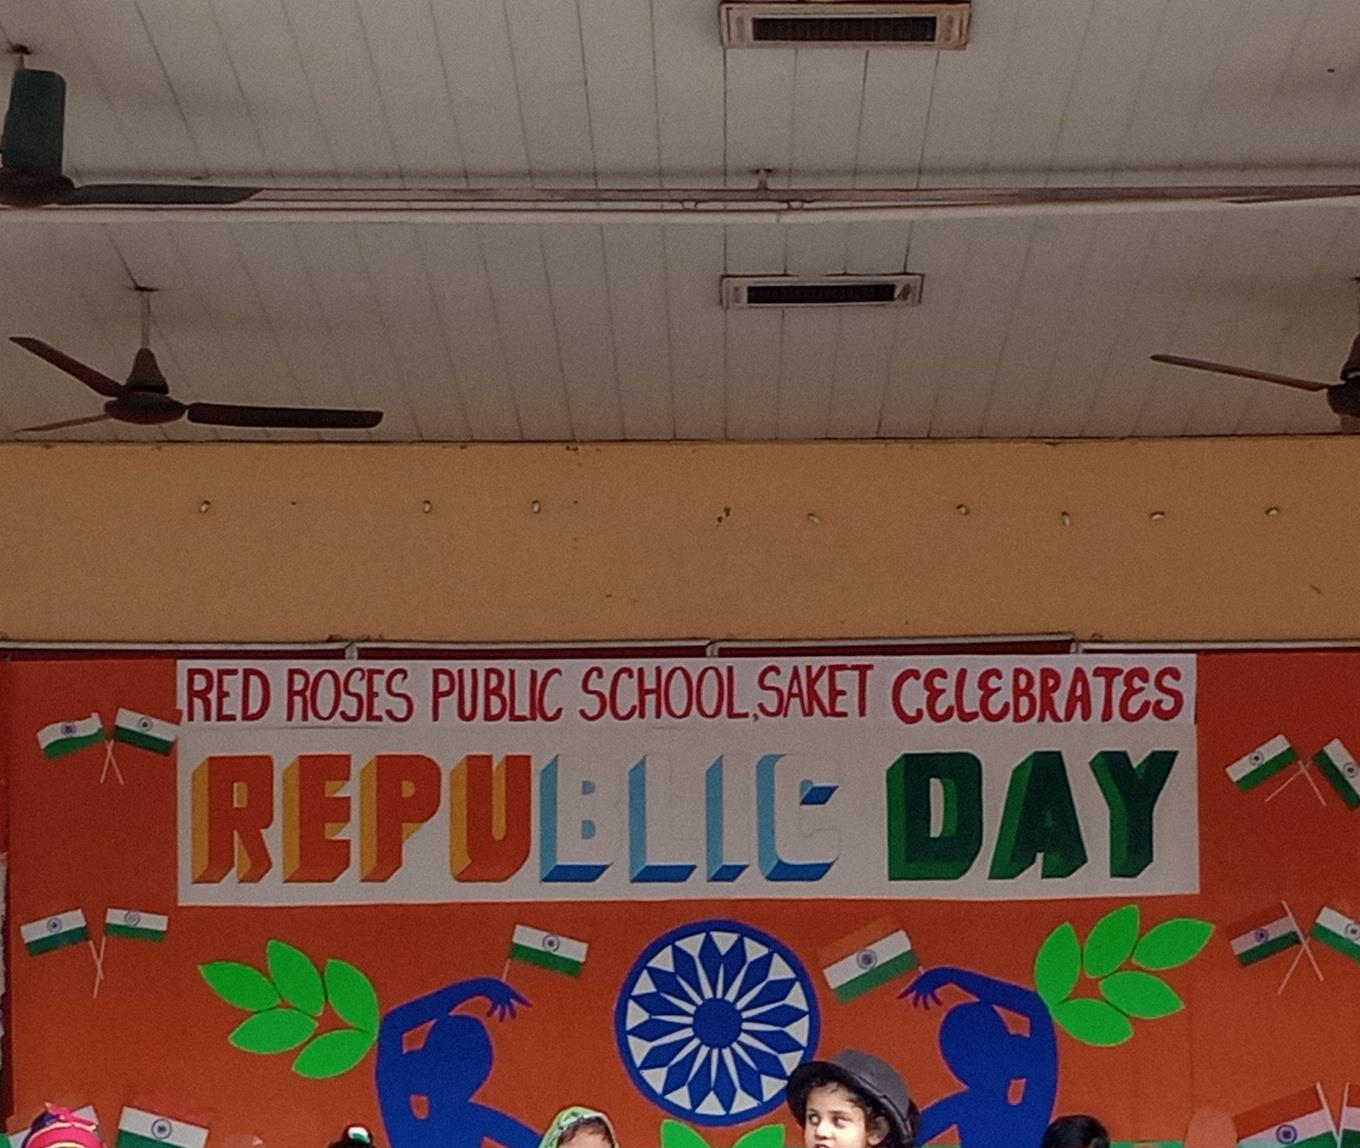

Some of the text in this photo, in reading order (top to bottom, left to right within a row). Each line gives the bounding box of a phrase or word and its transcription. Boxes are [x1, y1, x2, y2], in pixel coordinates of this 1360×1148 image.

[187, 668, 270, 722] RED
[287, 668, 414, 723] ROSES
[432, 667, 564, 722] PUBLIC
[891, 666, 1184, 725] CELEBRATES
[191, 750, 1179, 885] REPUBLIC DAY
